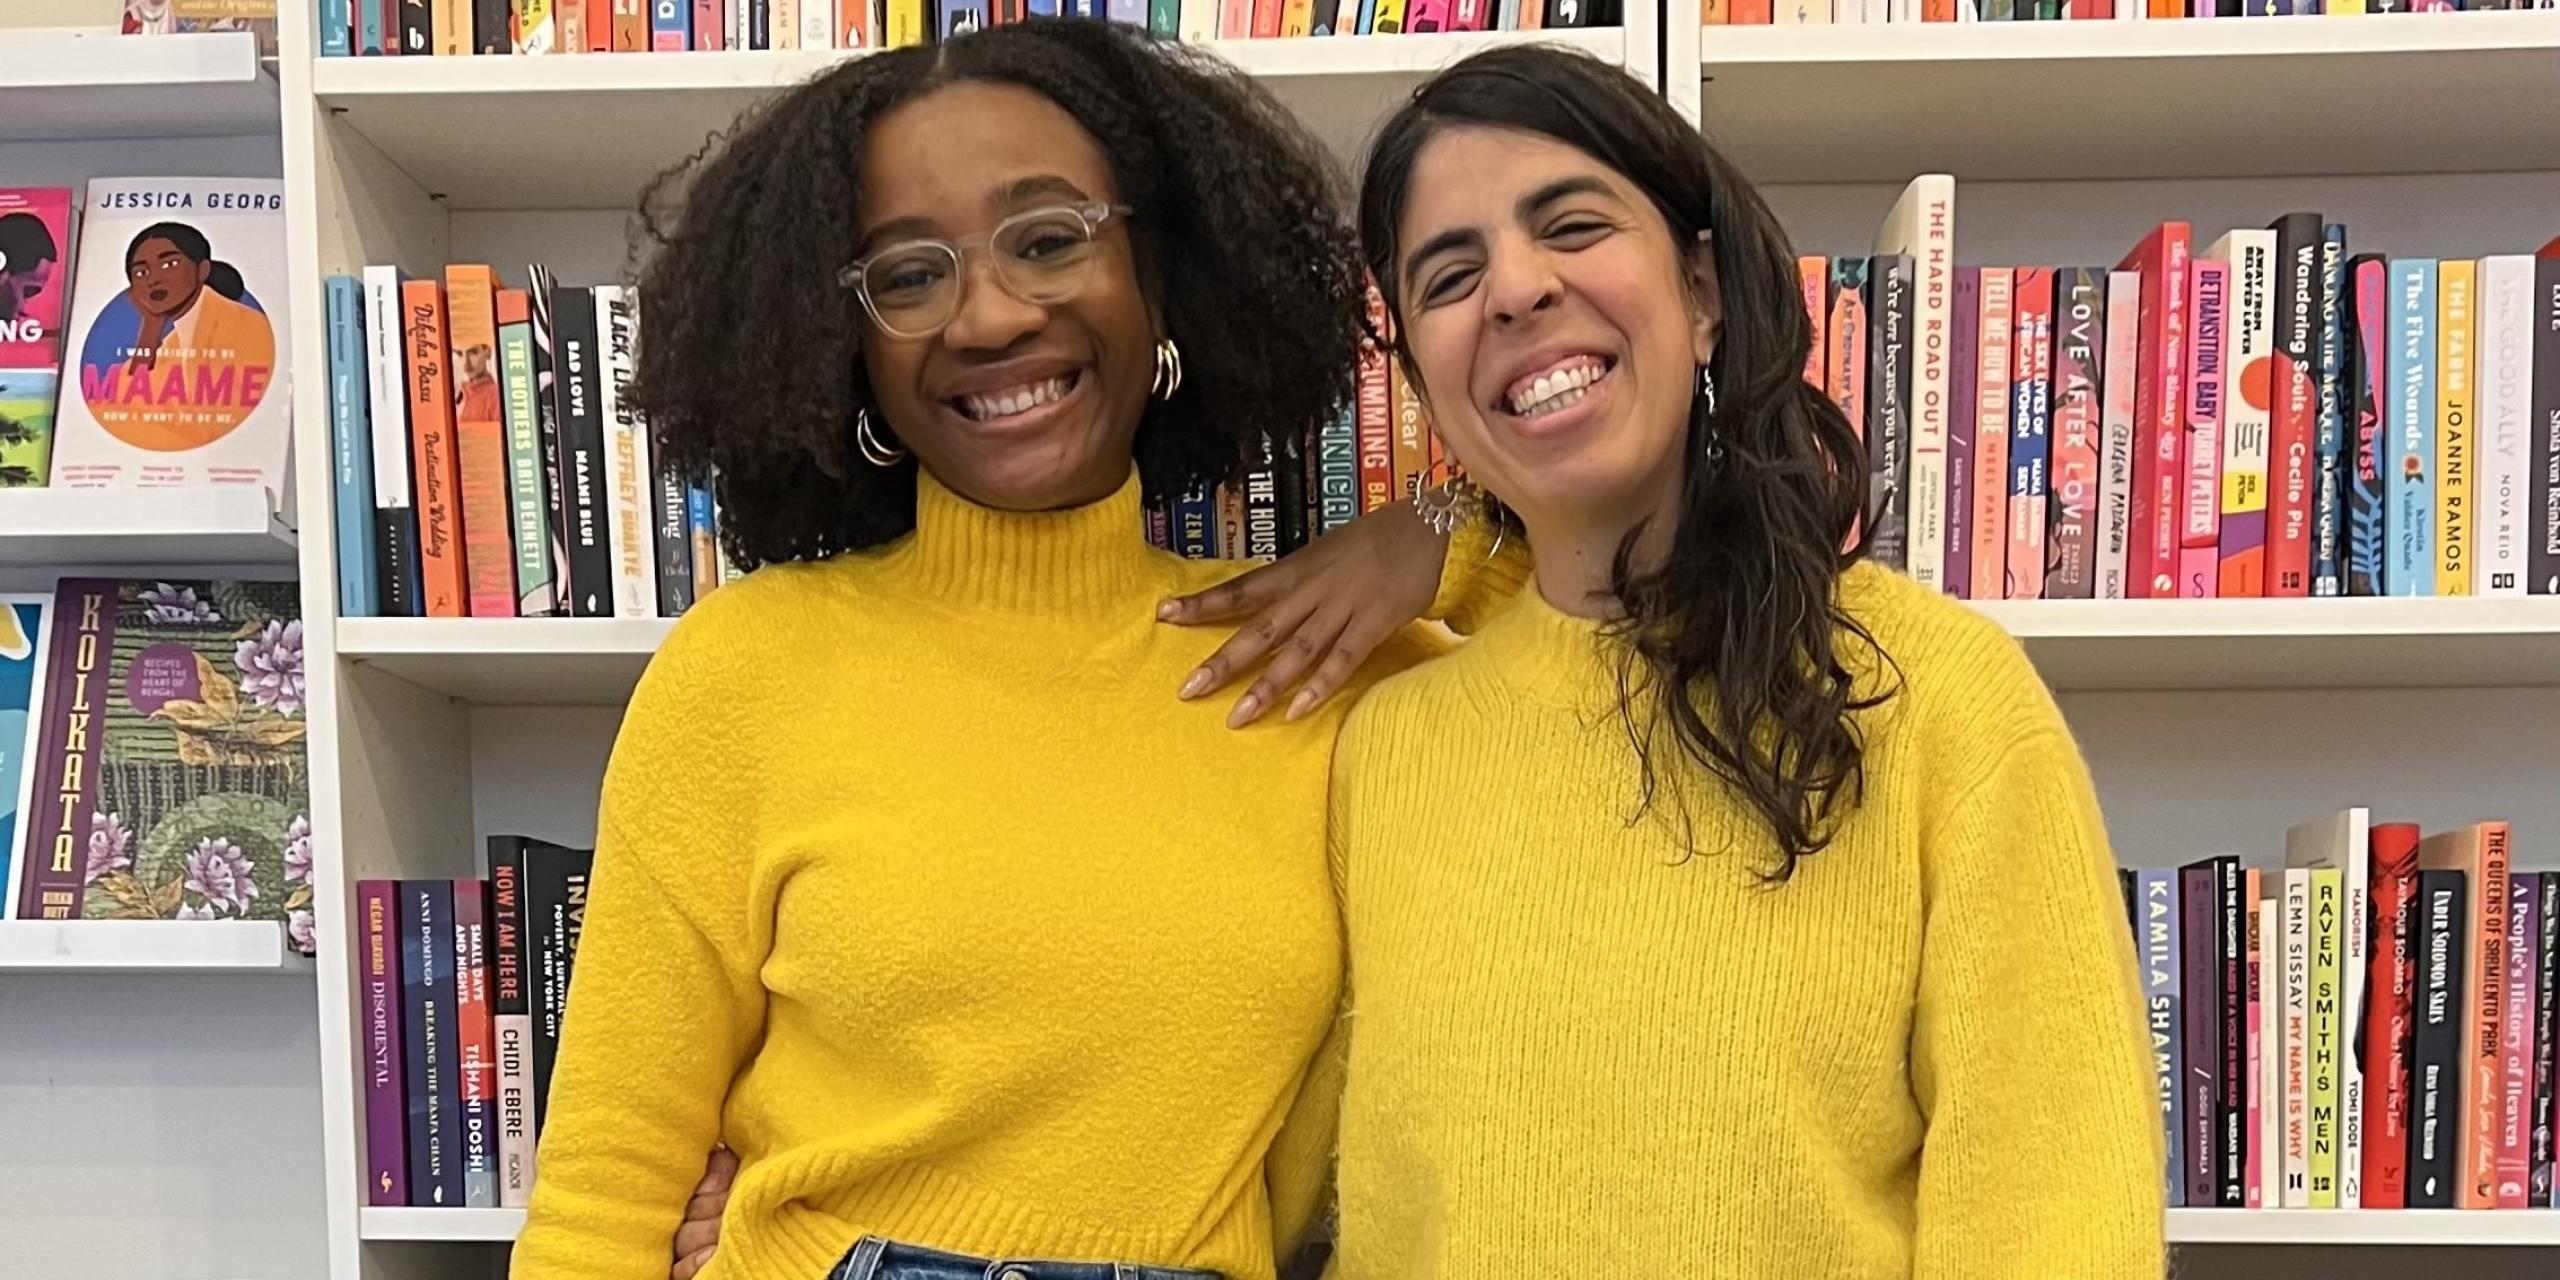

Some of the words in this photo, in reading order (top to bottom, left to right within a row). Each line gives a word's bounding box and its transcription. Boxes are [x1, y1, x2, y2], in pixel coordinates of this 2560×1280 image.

[100, 192, 193, 209] JESSICA
[207, 193, 281, 210] GEORG
[1930, 201, 1946, 240] THE
[1885, 267, 1903, 307] we're
[1927, 249, 1944, 309] HARD
[2243, 246, 2254, 308] BELOVED
[2253, 246, 2264, 289] AWAY
[1985, 275, 2009, 312] TELL
[2168, 271, 2183, 312] Book
[2252, 293, 2263, 331] FROM
[2289, 245, 2314, 353] Wandering
[2406, 268, 2424, 313] The
[2449, 279, 2467, 320] THE
[408, 304, 437, 359] Diksha
[608, 300, 632, 362] BLACK,
[1886, 311, 1902, 341] here
[1984, 316, 2007, 343] ME
[2070, 285, 2091, 359] LOVE
[2169, 313, 2183, 333] of
[2196, 270, 2221, 378] DETRANSITION,
[2240, 311, 2252, 355] LOVER
[2406, 317, 2423, 360] Five
[508, 341, 525, 370] THE
[568, 341, 581, 372] BAD
[1925, 319, 1942, 381] ROAD
[1983, 345, 2007, 383] HOW
[2448, 329, 2465, 391] FARM
[83, 363, 269, 408] MAAME
[420, 363, 438, 404] Basu
[571, 376, 585, 416] LOVE
[1884, 344, 1902, 404] because
[2290, 360, 2309, 411] Souls
[511, 375, 532, 450] MOTHERS
[1880, 406, 1898, 437] you
[1922, 391, 1940, 435] OUT
[1982, 389, 2005, 412] TO
[2017, 380, 2031, 438] WOMEN
[2066, 374, 2088, 447] AFTER
[2195, 381, 2217, 418] BABY
[2404, 364, 2423, 450] Wounds
[1981, 414, 2004, 435] BE
[2033, 416, 2045, 434] OF
[2359, 409, 2376, 481] ABYSS
[2447, 400, 2464, 486] JOANNE
[423, 431, 441, 504] Destination
[518, 459, 535, 497] BRIT
[575, 450, 590, 505] MAAME
[616, 431, 636, 505] JEFFREY
[1883, 440, 1897, 478] were
[1985, 443, 1997, 484] NEEL
[2288, 442, 2305, 503] Cecile
[2549, 456, 2559, 484] von
[1249, 471, 1275, 504] THE
[2061, 462, 2085, 537] LOVE
[2190, 479, 2214, 533] PETERS
[2500, 474, 2511, 518] NOVA
[425, 505, 446, 560] Wedding
[520, 501, 540, 570] BENNETT
[580, 510, 595, 547] BLUE
[1185, 512, 1203, 539] ZEN
[1951, 527, 1961, 552] PARK
[1983, 495, 1995, 545] PATEL
[2286, 510, 2303, 539] Pin
[2445, 497, 2462, 573] RAMOS
[2499, 524, 2510, 559] REID
[50, 594, 104, 873] KOLKATA
[2488, 829, 2506, 856] THE
[420, 892, 432, 923] ANNI
[497, 866, 514, 906] NOW
[2486, 860, 2505, 916] QUEENS
[2513, 882, 2528, 898] A
[554, 904, 564, 957] POVERTY,
[2289, 883, 2303, 935] LEMN
[2319, 885, 2334, 967] RAVEN
[2350, 888, 2362, 957] MANORISM
[2431, 890, 2453, 930] UNDER
[2485, 919, 2501, 935] OF
[456, 924, 468, 953] AND
[470, 924, 482, 965] SMALL
[500, 924, 516, 948] AM
[2149, 881, 2169, 986] KAMILA
[2508, 902, 2528, 977] People's
[421, 925, 435, 987] DOMINGO
[501, 954, 518, 999] HERE
[544, 950, 553, 976] NEW
[2289, 944, 2303, 1010] SISSAY
[2482, 939, 2500, 1017] SARMIENTO
[457, 957, 470, 1005] NIGHTS
[472, 967, 484, 1001] DAYS
[545, 980, 554, 1009] YORK
[556, 961, 567, 1014] SURVIVAL
[371, 981, 388, 1089] DISORIENTAL
[425, 1000, 438, 1064] BREAKING
[546, 1013, 556, 1038] CITY
[2290, 1016, 2302, 1042] MY
[2317, 982, 2334, 1092] SMITH'S
[2504, 983, 2524, 1052] History
[502, 1028, 521, 1078] CHIDI
[2481, 1021, 2498, 1060] PARK
[427, 1068, 438, 1093] THE
[464, 1043, 483, 1113] TISHANI
[2289, 1045, 2302, 1097] NAME
[2507, 1055, 2524, 1075] of
[428, 1095, 440, 1135] MAAFA
[504, 1087, 523, 1139] EBERE
[2199, 1086, 2210, 1117] GOGU
[2290, 1099, 2301, 1115] IS
[2348, 1080, 2359, 1112] YOMI
[2505, 1081, 2522, 1147] Heaven
[467, 1118, 483, 1173] DOSHI
[2289, 1118, 2302, 1159] WHY
[2314, 1106, 2331, 1155] MEN
[2347, 1116, 2358, 1148] SODE
[430, 1137, 441, 1177] CHAIN
